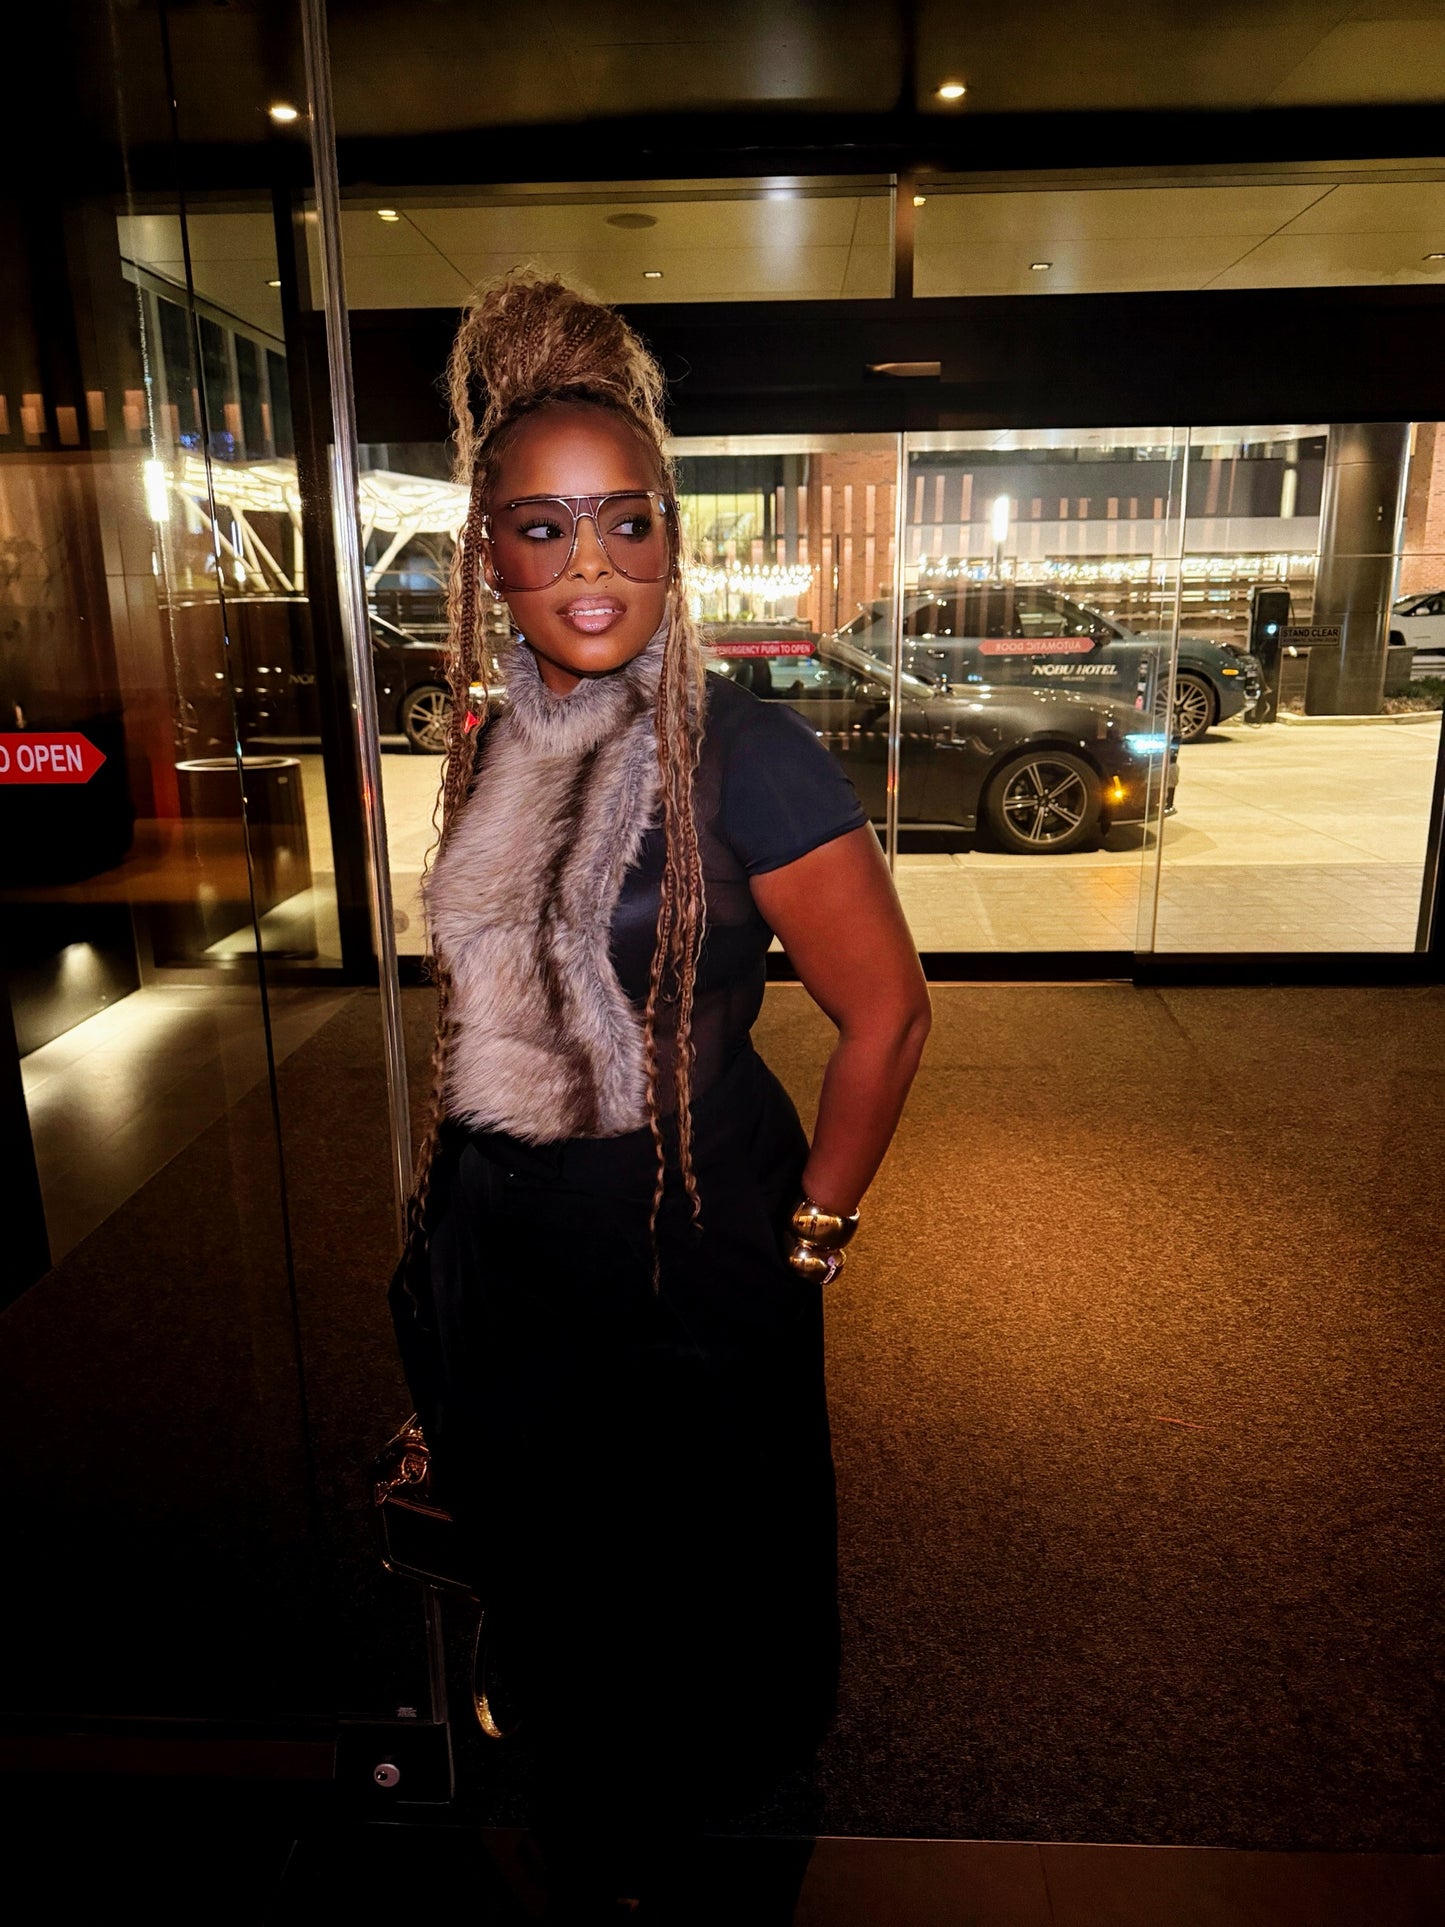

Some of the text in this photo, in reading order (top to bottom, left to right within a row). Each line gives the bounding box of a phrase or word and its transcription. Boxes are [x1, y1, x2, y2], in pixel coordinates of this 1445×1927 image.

[1283, 629, 1339, 637] STAND CLEAR
[761, 645, 780, 654] PUSH
[781, 644, 790, 654] TO
[791, 644, 811, 654] OPEN
[1032, 664, 1118, 676] NOBU HOTEL
[17, 744, 83, 773] OPEN
